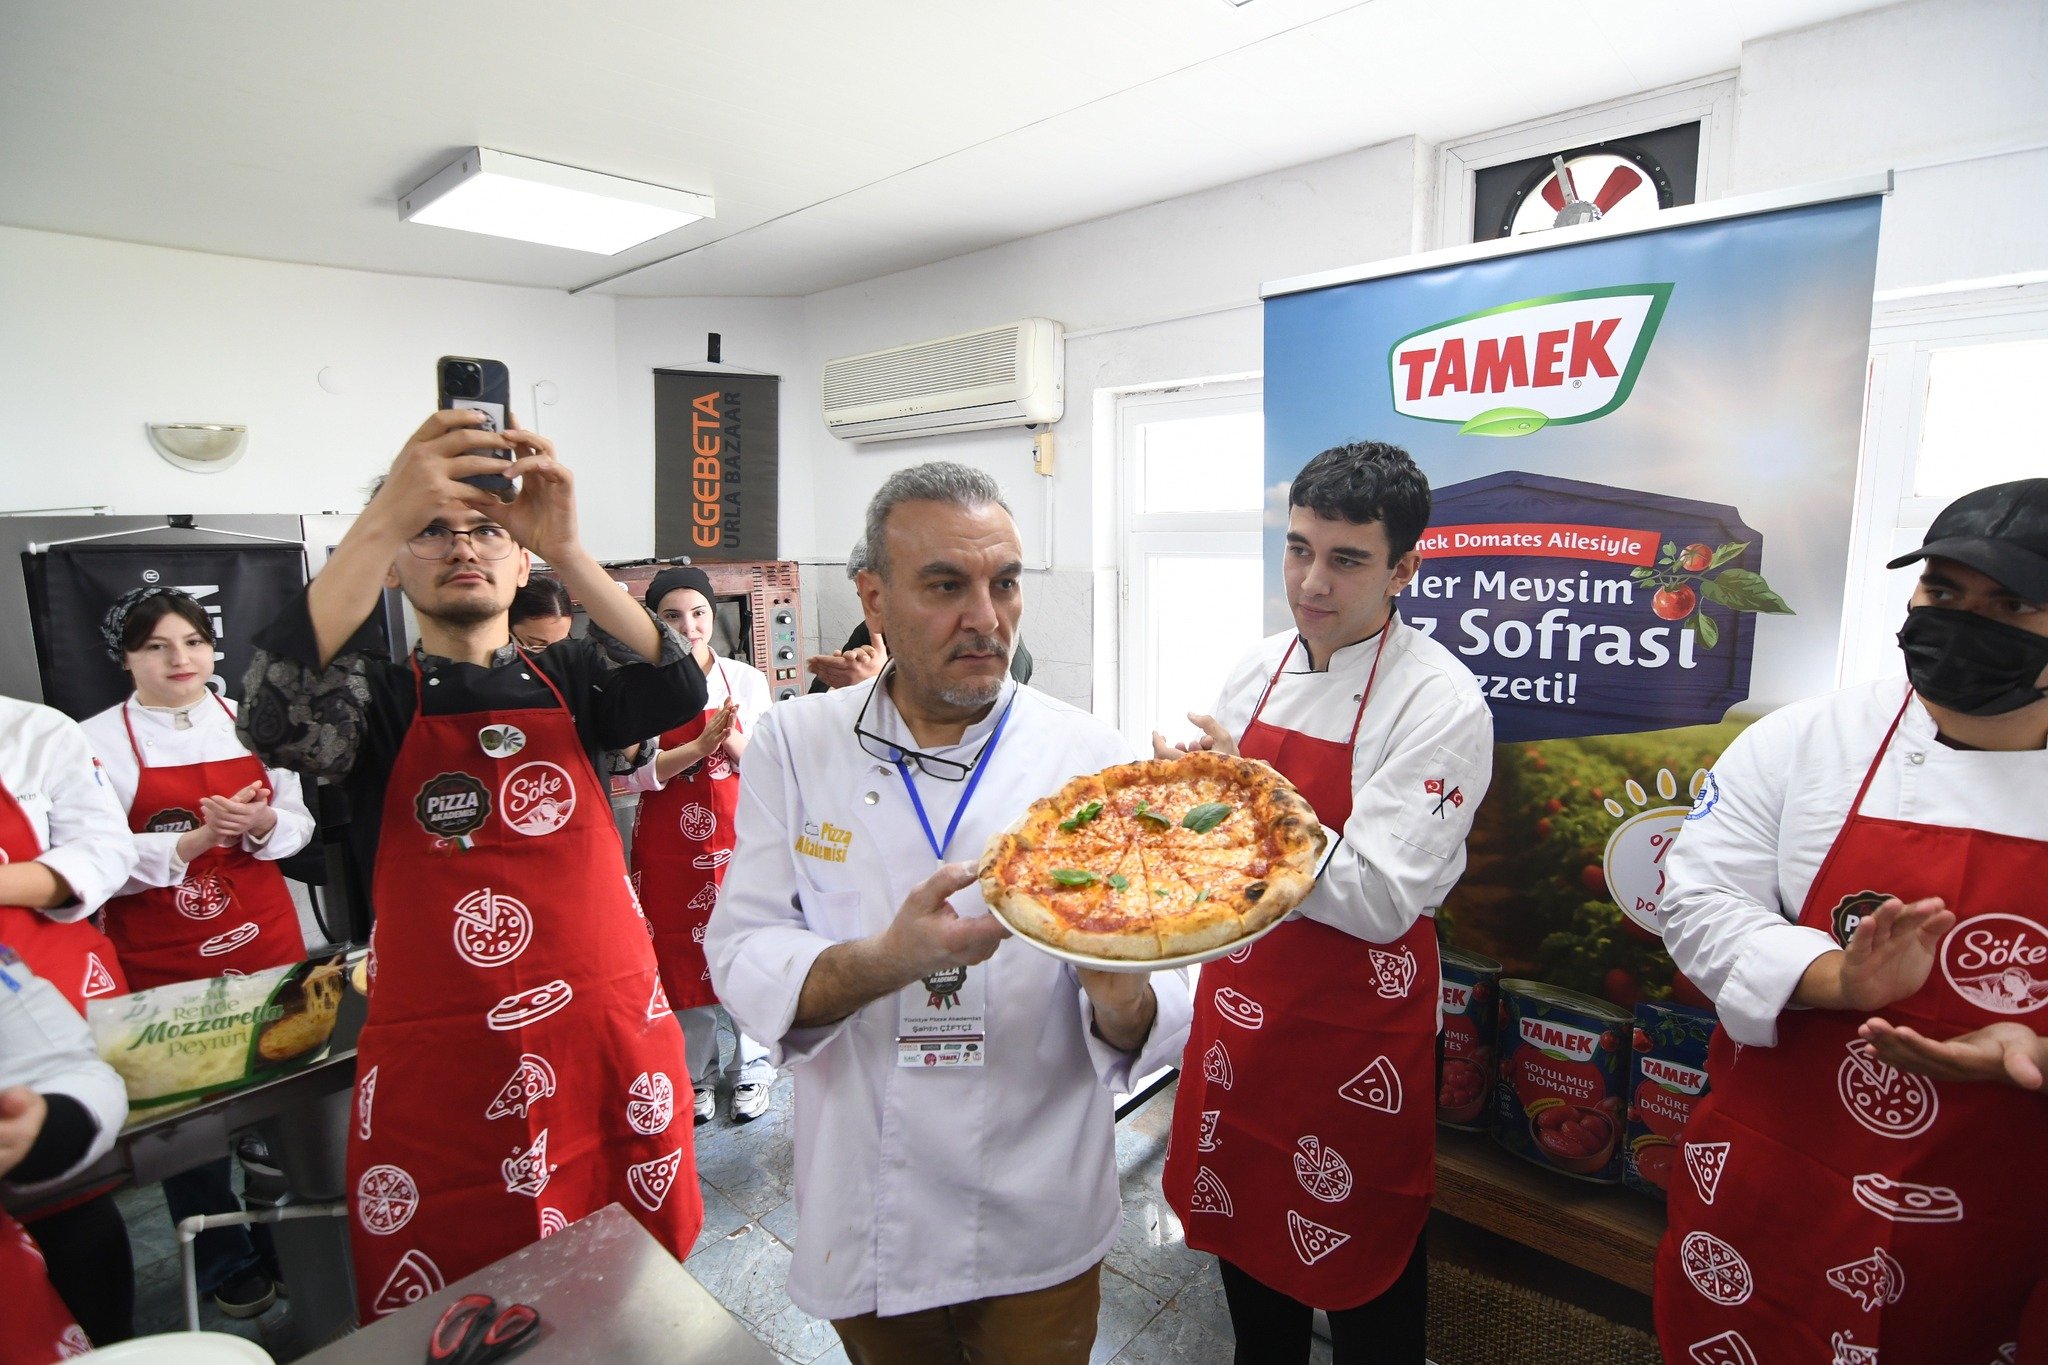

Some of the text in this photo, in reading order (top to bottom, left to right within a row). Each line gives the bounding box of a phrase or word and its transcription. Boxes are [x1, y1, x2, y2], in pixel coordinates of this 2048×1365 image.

[1399, 317, 1622, 402] TAMEK
[692, 391, 721, 548] EGEBETA
[723, 391, 741, 549] URLA BAZAAR
[1454, 532, 1542, 548] Domates
[1547, 531, 1642, 557] Ailesiyle
[1473, 570, 1634, 605] Mevsim
[1458, 608, 1698, 669] Sofrası
[509, 771, 562, 812] Söke
[821, 821, 853, 846] Pizza
[1957, 930, 2048, 970] Söke
[126, 1004, 285, 1051] Mozzarella
[173, 999, 240, 1022] Rende
[1521, 1019, 1593, 1054] TAMEK
[1524, 1060, 1595, 1091] SOYULMUŞ
[1527, 1072, 1589, 1100] DOMATES
[1642, 1059, 1701, 1089] TAMEK
[1640, 1098, 1690, 1124] DOMAT
[1657, 1094, 1690, 1113] PÜRE
